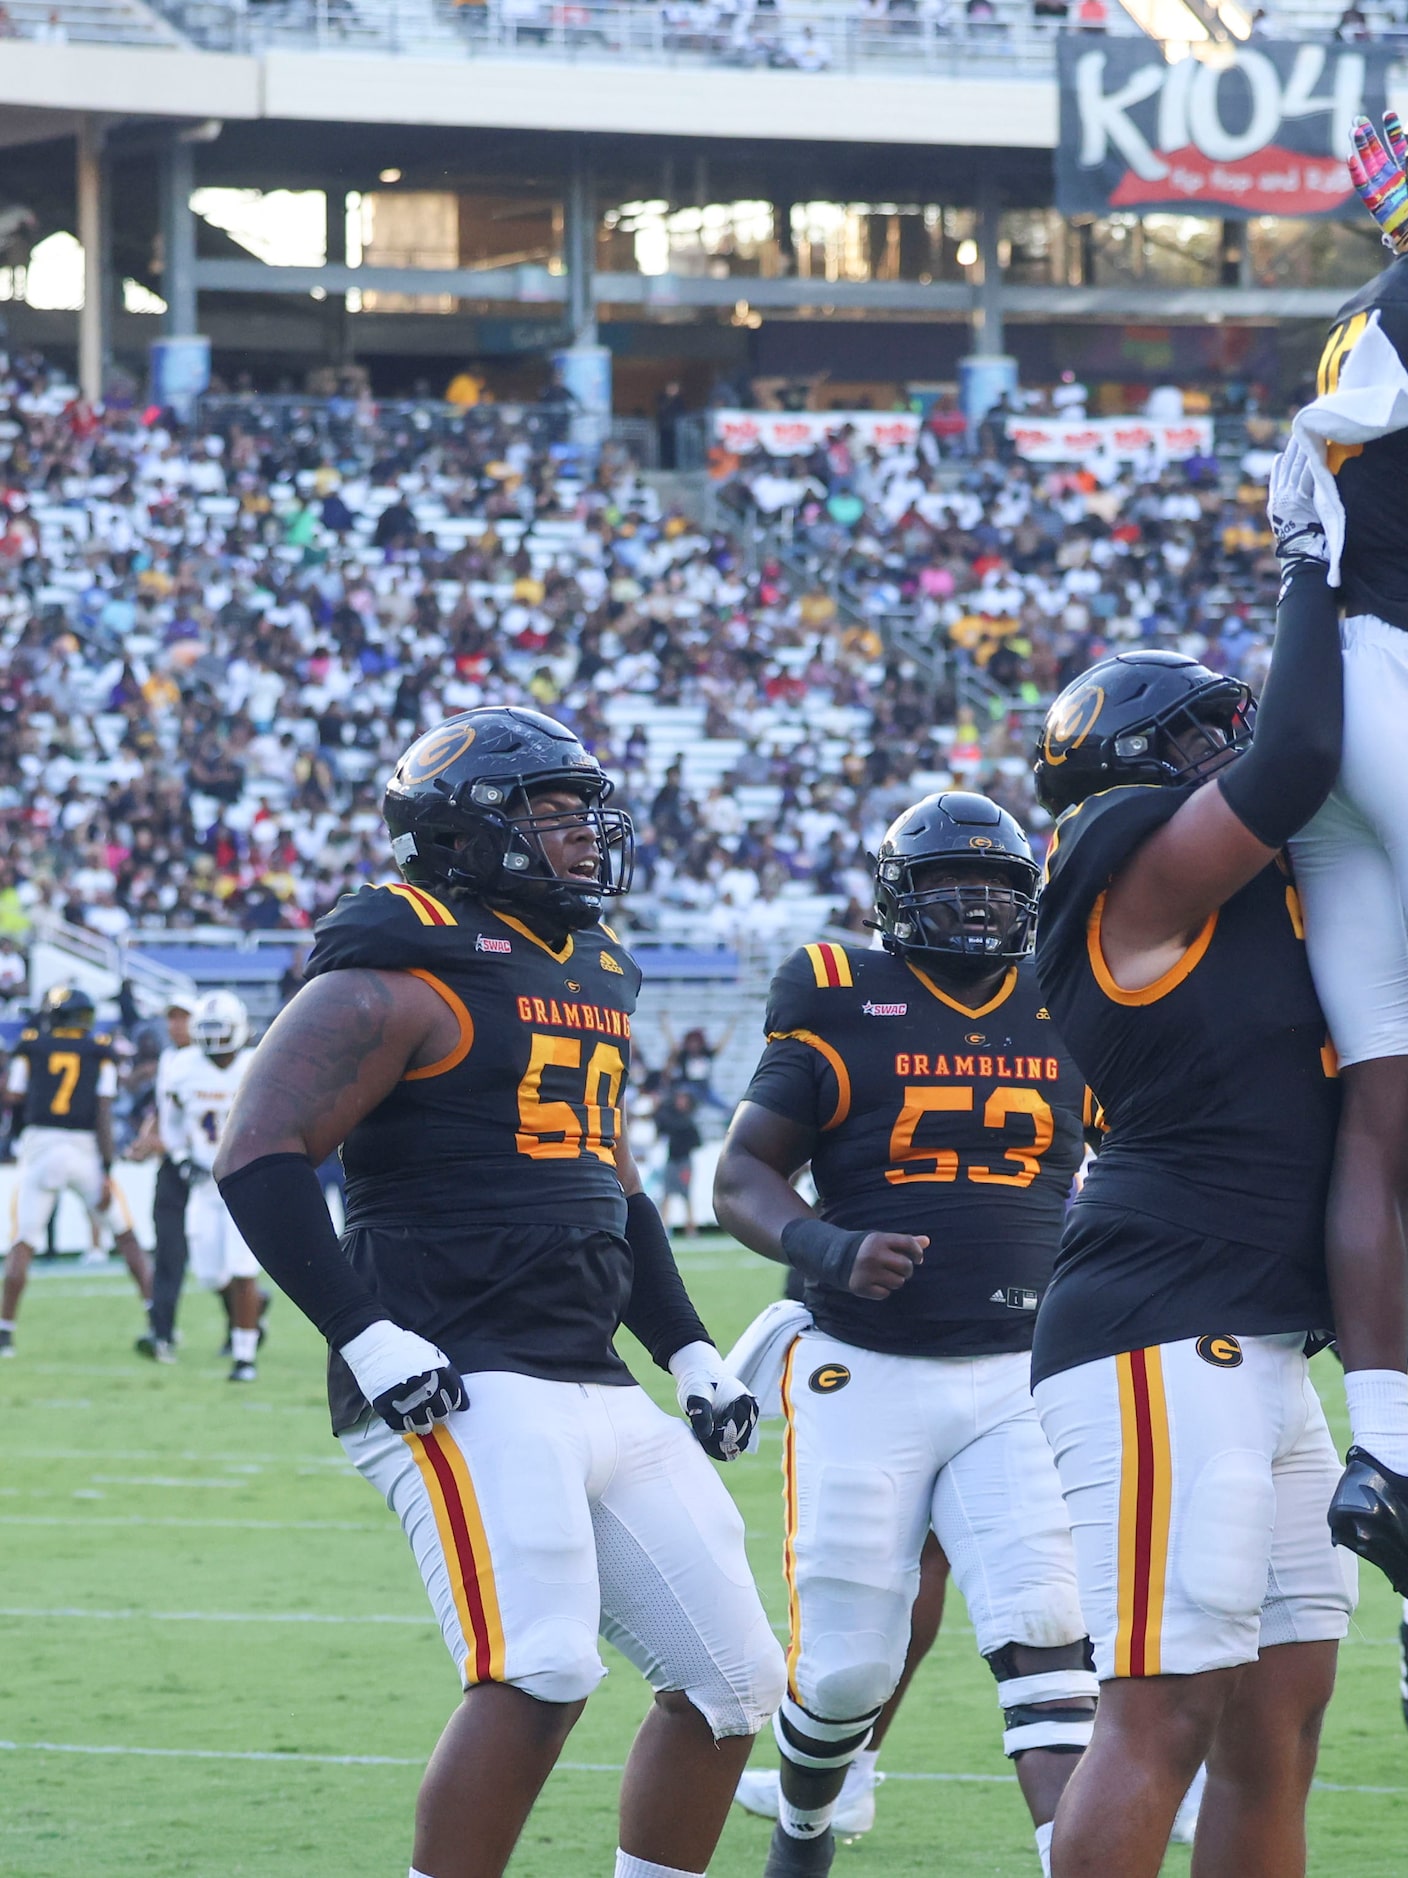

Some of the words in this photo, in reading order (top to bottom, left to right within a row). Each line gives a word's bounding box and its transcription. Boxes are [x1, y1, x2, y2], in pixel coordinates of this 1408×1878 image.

[482, 939, 511, 952] SWAC
[517, 996, 632, 1041] GRAMBLING
[873, 1005, 907, 1015] SWAC
[48, 1051, 81, 1115] 7
[895, 1053, 1059, 1081] GRAMBLING
[514, 1032, 626, 1167] 50
[884, 1086, 1055, 1188] 53
